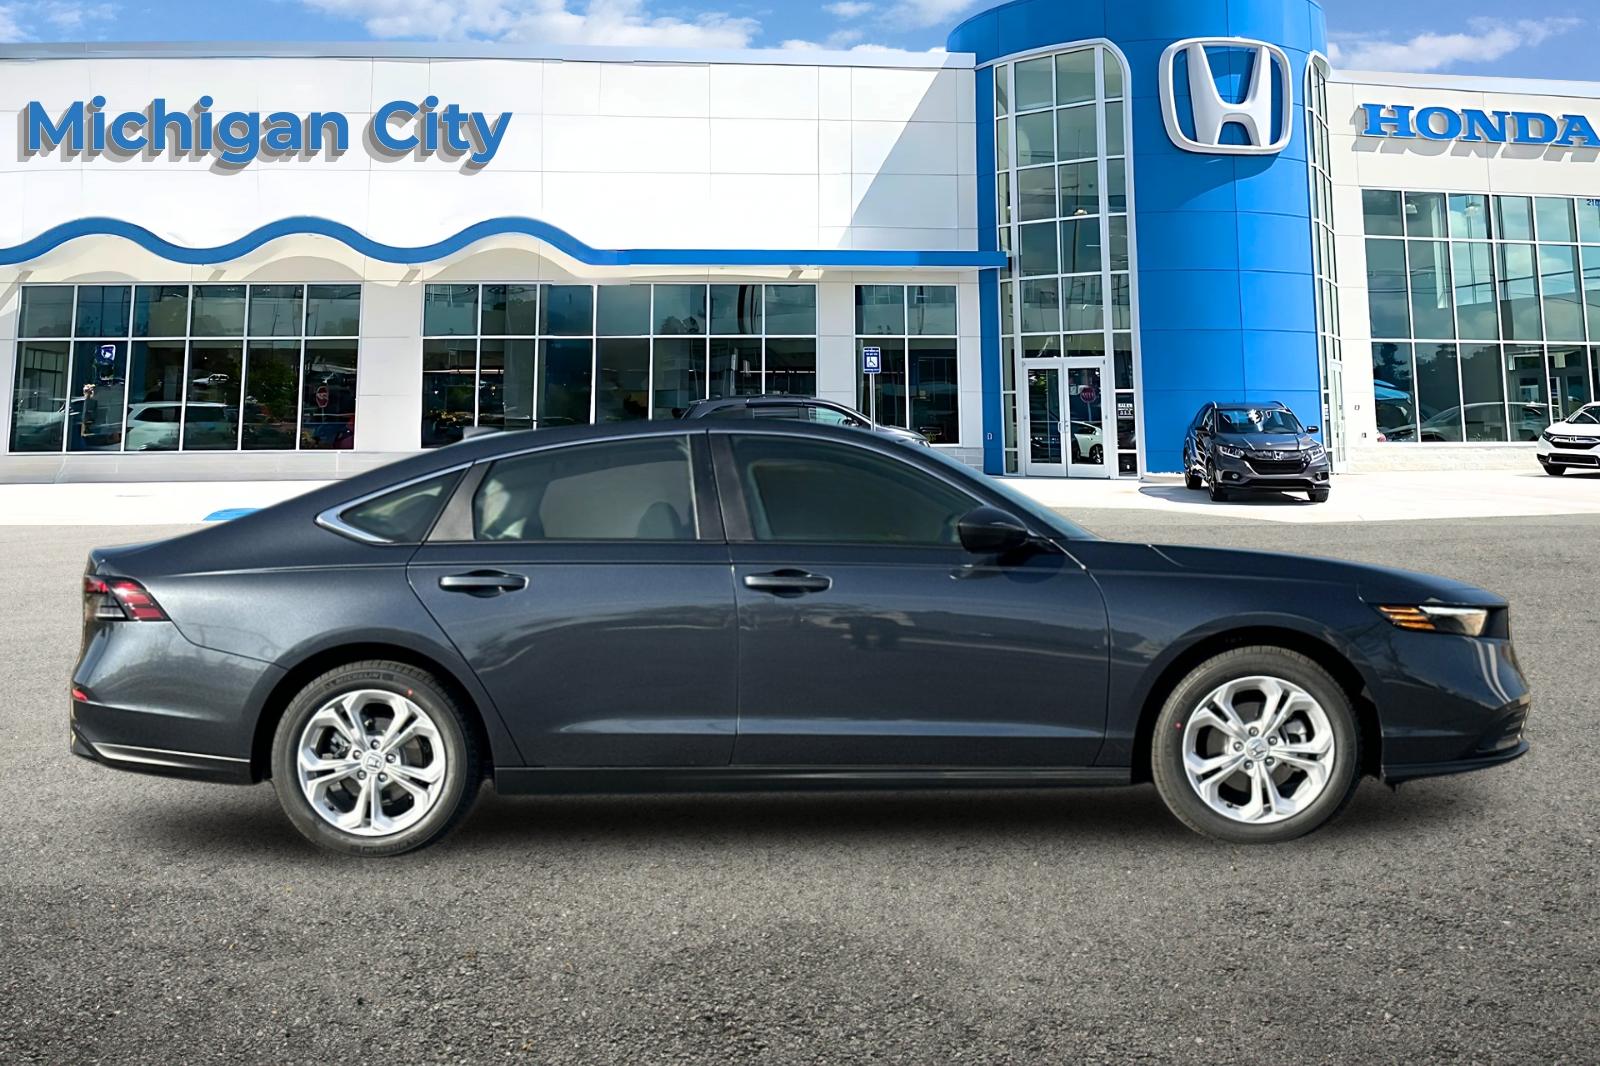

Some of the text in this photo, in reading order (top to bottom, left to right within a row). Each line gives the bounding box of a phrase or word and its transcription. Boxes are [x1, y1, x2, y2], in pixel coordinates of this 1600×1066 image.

[28, 95, 513, 165] Michigan City
[1361, 103, 1600, 148] HONDA
